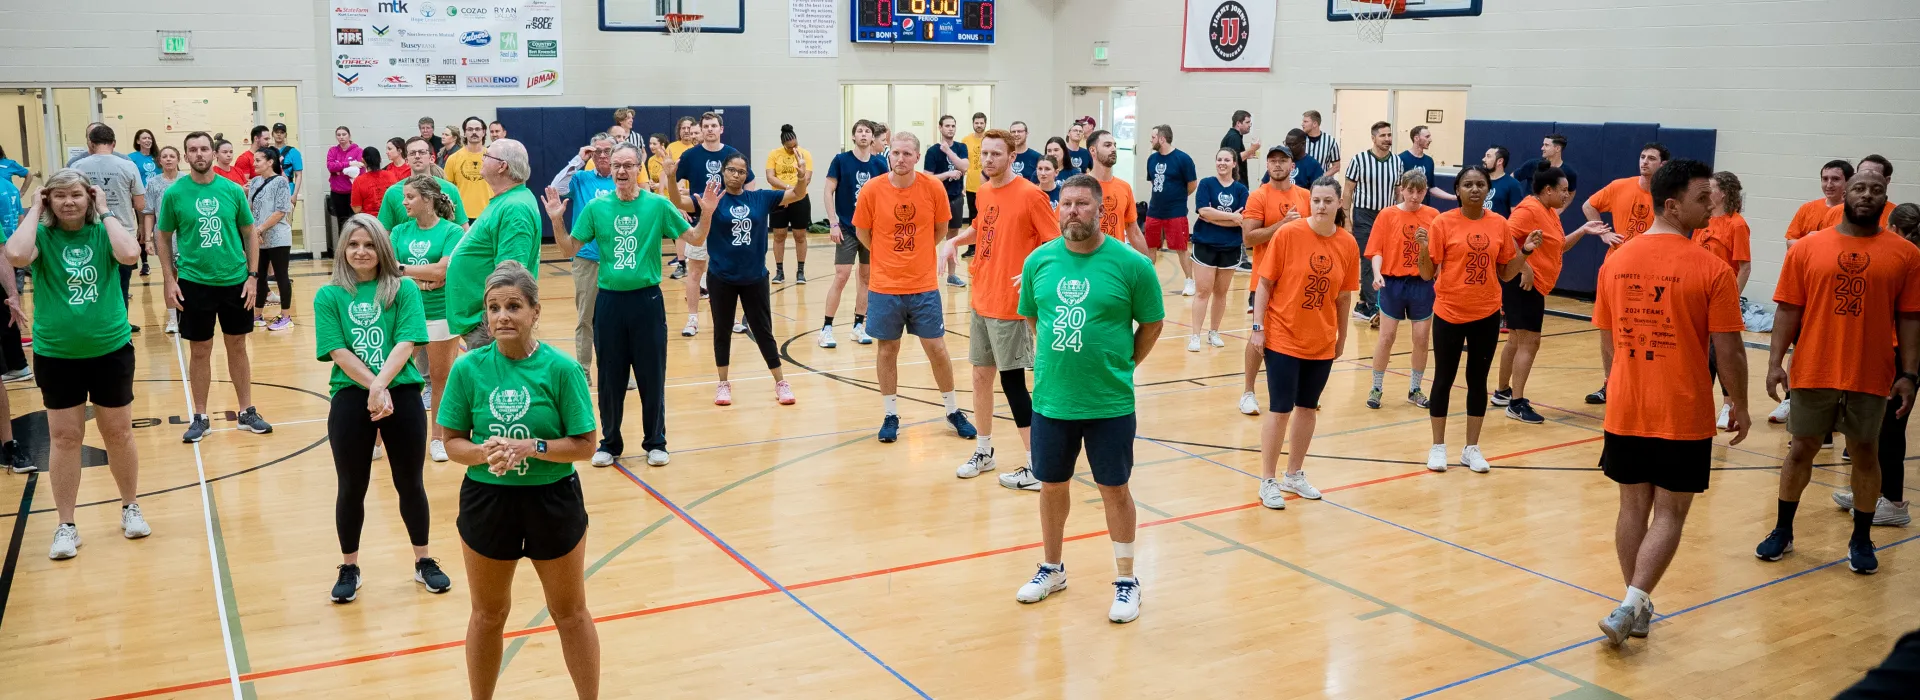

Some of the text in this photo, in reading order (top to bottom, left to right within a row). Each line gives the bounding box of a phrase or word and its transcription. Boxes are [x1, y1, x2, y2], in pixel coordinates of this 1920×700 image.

[378, 0, 408, 13] mtk
[980, 2, 992, 30] 0
[1212, 4, 1230, 28] JIMMY
[1220, 18, 1240, 46] JJ
[527, 72, 556, 88] LIBMAN
[199, 216, 221, 232] 20
[732, 218, 752, 232] 20
[1101, 212, 1117, 227] 20
[1628, 219, 1647, 233] 20
[894, 223, 916, 237] 20
[200, 231, 222, 248] 24
[614, 236, 638, 252] 20
[732, 232, 751, 246] 24
[894, 236, 915, 252] 24
[1403, 241, 1420, 254] 20
[614, 252, 636, 270] 24
[1466, 252, 1490, 269] 20
[66, 265, 98, 285] 20
[1464, 269, 1487, 285] 24
[1305, 275, 1330, 293] 20
[1834, 274, 1866, 297] 20
[68, 284, 98, 304] 24
[1302, 292, 1325, 310] 24
[1834, 295, 1862, 316] 24
[1053, 306, 1086, 330] 20
[351, 327, 384, 350] 20
[1052, 328, 1082, 352] 24
